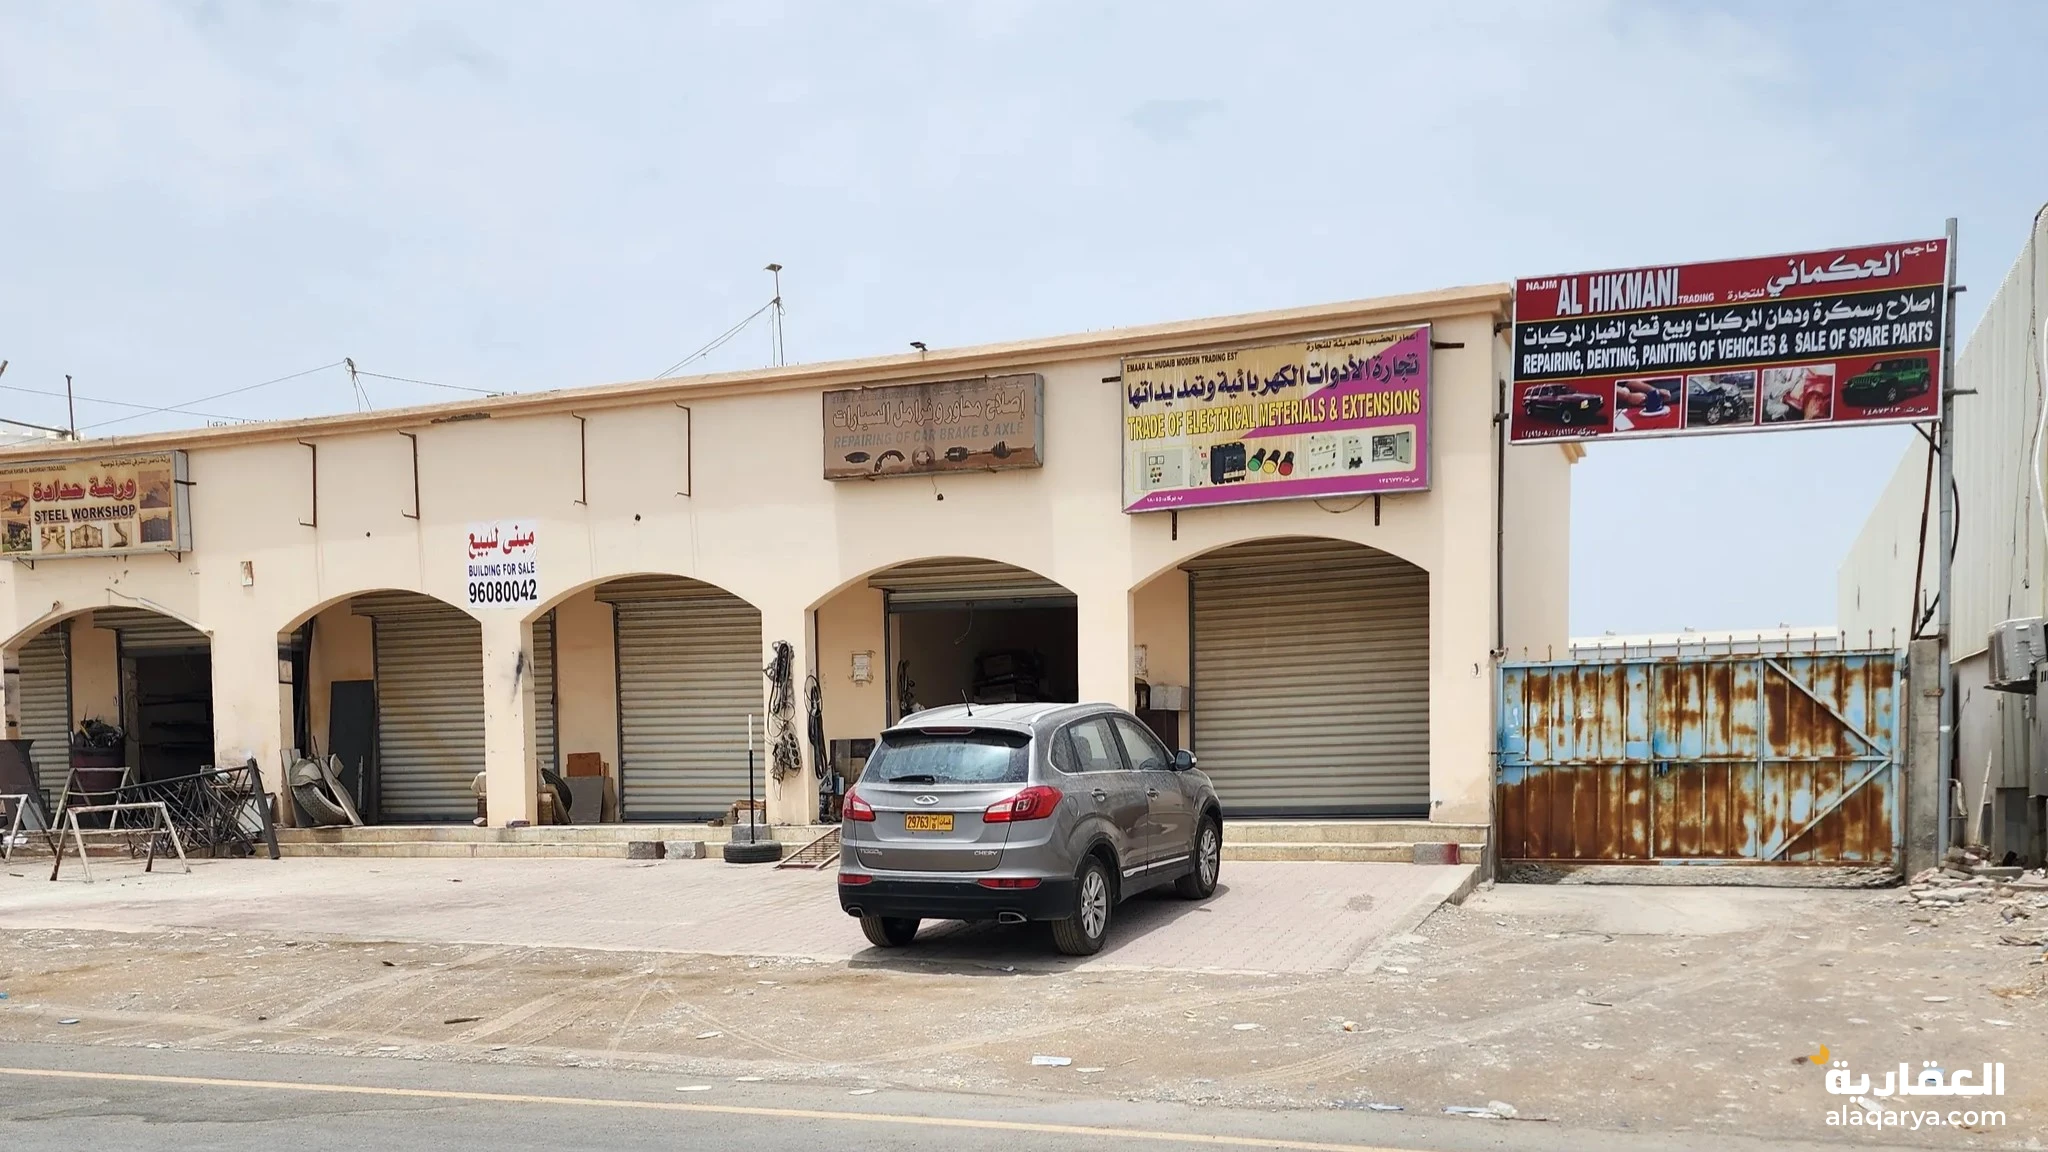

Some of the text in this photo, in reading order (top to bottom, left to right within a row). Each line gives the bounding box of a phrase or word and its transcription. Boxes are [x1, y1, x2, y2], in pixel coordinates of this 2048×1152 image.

[1902, 241, 1938, 257] ناجم
[1525, 280, 1558, 292] NAJIM
[1766, 249, 1900, 298] الحكماني
[1556, 267, 1679, 316] AL HIKMANI
[1678, 292, 1715, 304] TRADING
[1727, 288, 1765, 301] للتجارة
[1523, 291, 1935, 349] إصلاح وسمكرة ودهان المركبات وبيع قطع الغيار المركبات
[1306, 341, 1331, 352] للتجارة
[1523, 320, 1933, 375] REPAIRING, DENTING, PAINTING OF VEHICLES & SALE OF SPARE PARTS
[1127, 363, 1146, 373] EMAAR
[1147, 362, 1154, 371] AL
[1176, 356, 1200, 367] MODERN
[1201, 353, 1226, 364] TRADING
[1227, 351, 1238, 361] EST
[1127, 353, 1420, 410] تجارة الأدوات الكهربائية وتمديداتها
[832, 402, 891, 432] السيارات
[945, 395, 983, 424] محاور
[1127, 388, 1421, 441] TRADE OF ELECTRICAL METERIALS & EXTENSIONS
[833, 422, 1024, 449] REPAIRING OF CAR BRAKE & AXLE
[32, 475, 137, 502] ورشة حدادة
[34, 504, 136, 523] STEEL WORKSHOP
[469, 562, 535, 577] BUILDING FOR SALE
[469, 578, 537, 604] 96080042
[907, 815, 929, 829] 29763
